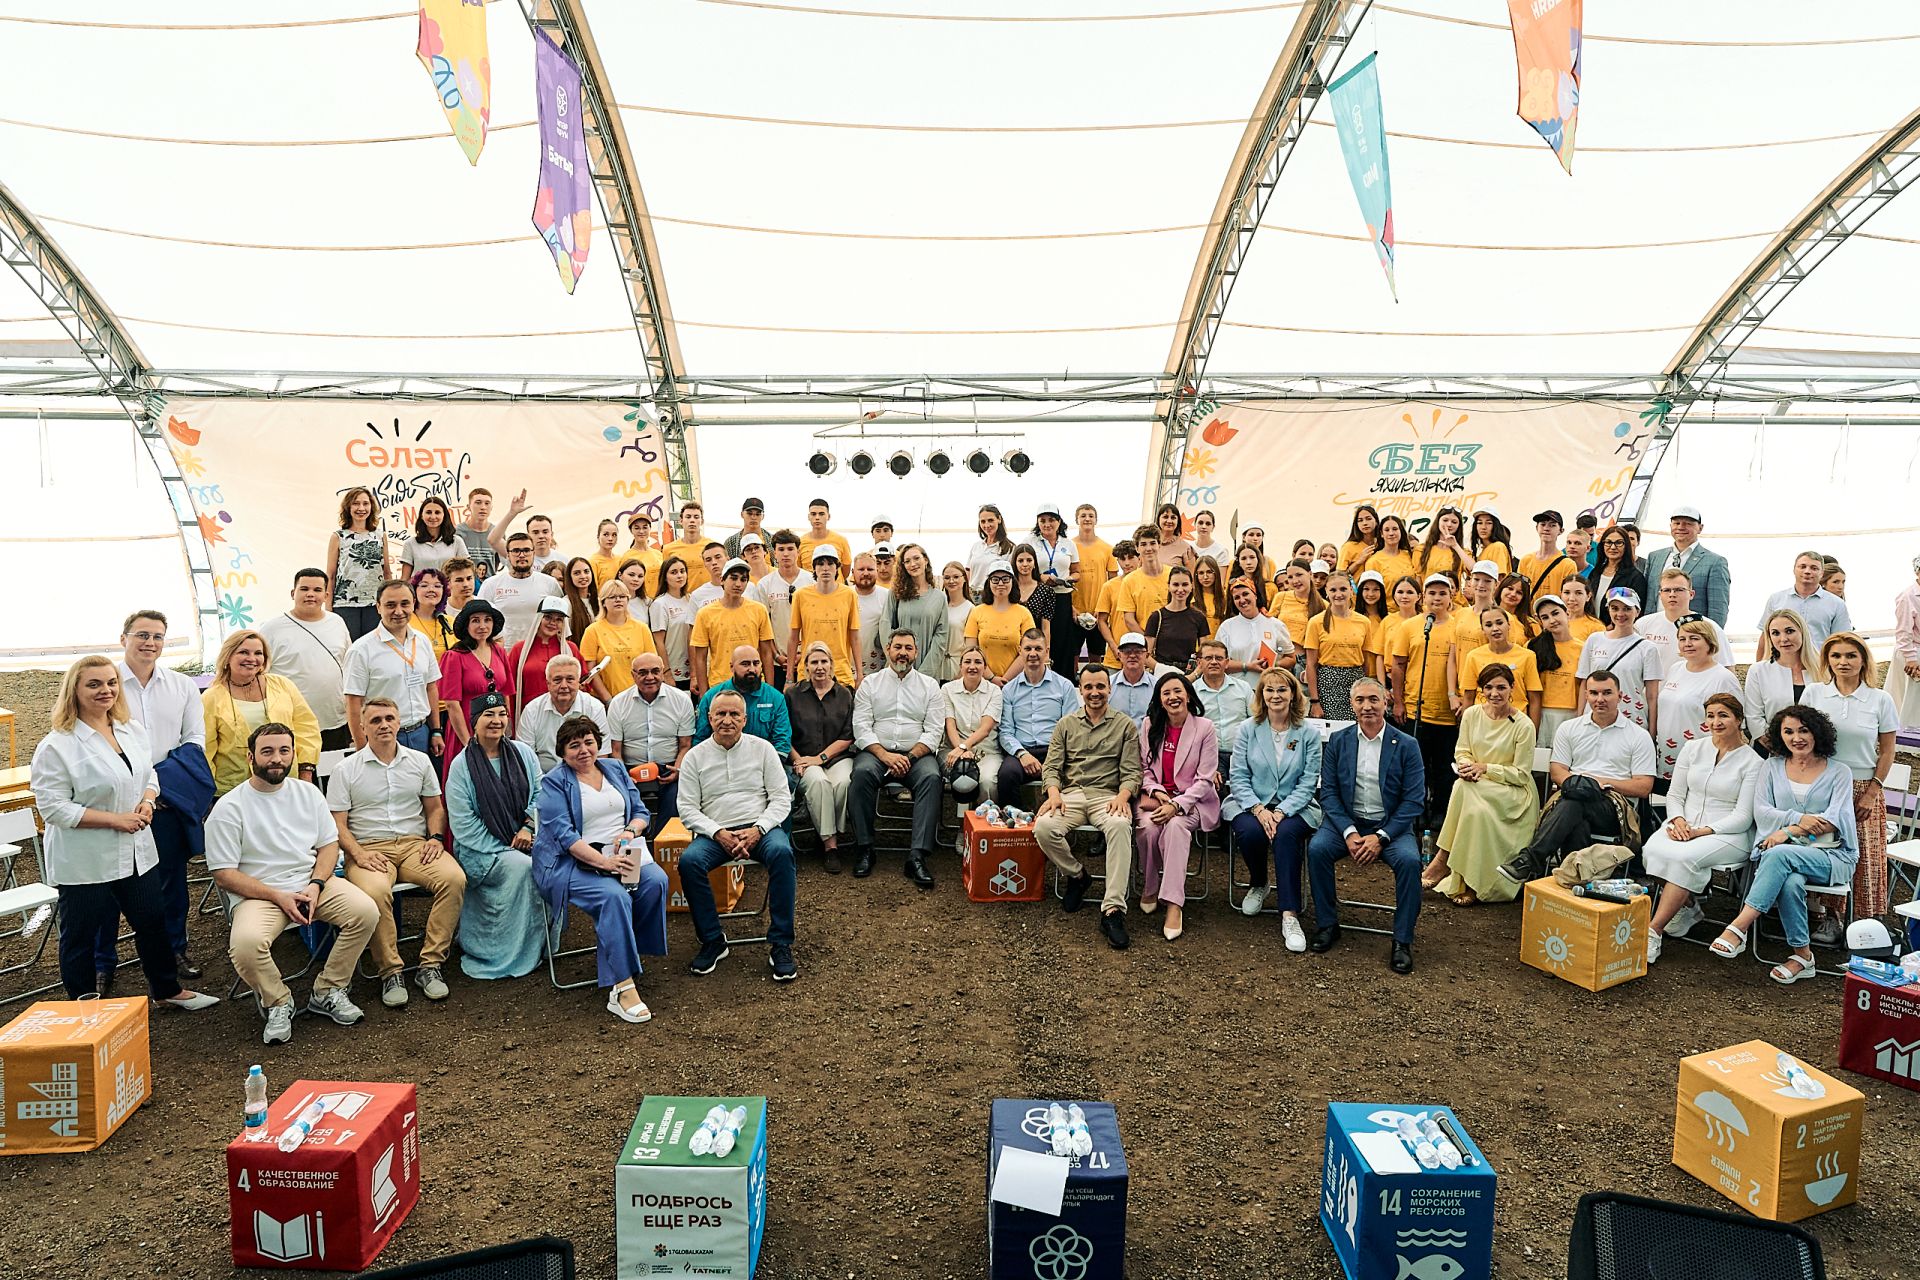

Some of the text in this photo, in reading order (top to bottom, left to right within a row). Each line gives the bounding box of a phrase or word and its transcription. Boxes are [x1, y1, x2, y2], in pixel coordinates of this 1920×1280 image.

[548, 145, 574, 179] Батыр
[345, 438, 453, 469] Сәләт
[1368, 443, 1484, 476] БЕЗ
[659, 847, 671, 862] 11
[979, 838, 988, 855] 9
[1528, 894, 1537, 912] 7
[1635, 954, 1642, 973] 7
[324, 1001, 336, 1011] N
[1857, 989, 1871, 1011] 8
[1879, 994, 1914, 1008] ЛАЕКЛЫ
[98, 1043, 109, 1071] 11
[1706, 1059, 1732, 1073] 2
[403, 1111, 415, 1128] 4
[333, 1130, 356, 1146] 4
[409, 1126, 417, 1162] QUALITY
[1796, 1124, 1807, 1149] 2
[402, 1134, 411, 1183] EDUCATION
[632, 1147, 661, 1160] 13
[1089, 1151, 1111, 1169] 17
[257, 1169, 340, 1180] КАЧЕСТВЕННОЕ
[1711, 1154, 1742, 1180] HUNGER
[237, 1168, 251, 1192] 4
[258, 1179, 335, 1189] ОБРАЗОВАНИЕ
[1719, 1174, 1741, 1195] ZERO
[631, 1194, 733, 1210] ПОДБРОСЬ
[1411, 1189, 1482, 1199] СОХРАНЕНИЕ
[1748, 1179, 1761, 1207] 2
[1323, 1190, 1334, 1220] 14
[1379, 1189, 1402, 1216] 14
[1410, 1198, 1461, 1207] МОРСКИХ
[1410, 1207, 1466, 1216] РЕСУРСОВ
[643, 1214, 722, 1230] ЕЩЕ РАЗ
